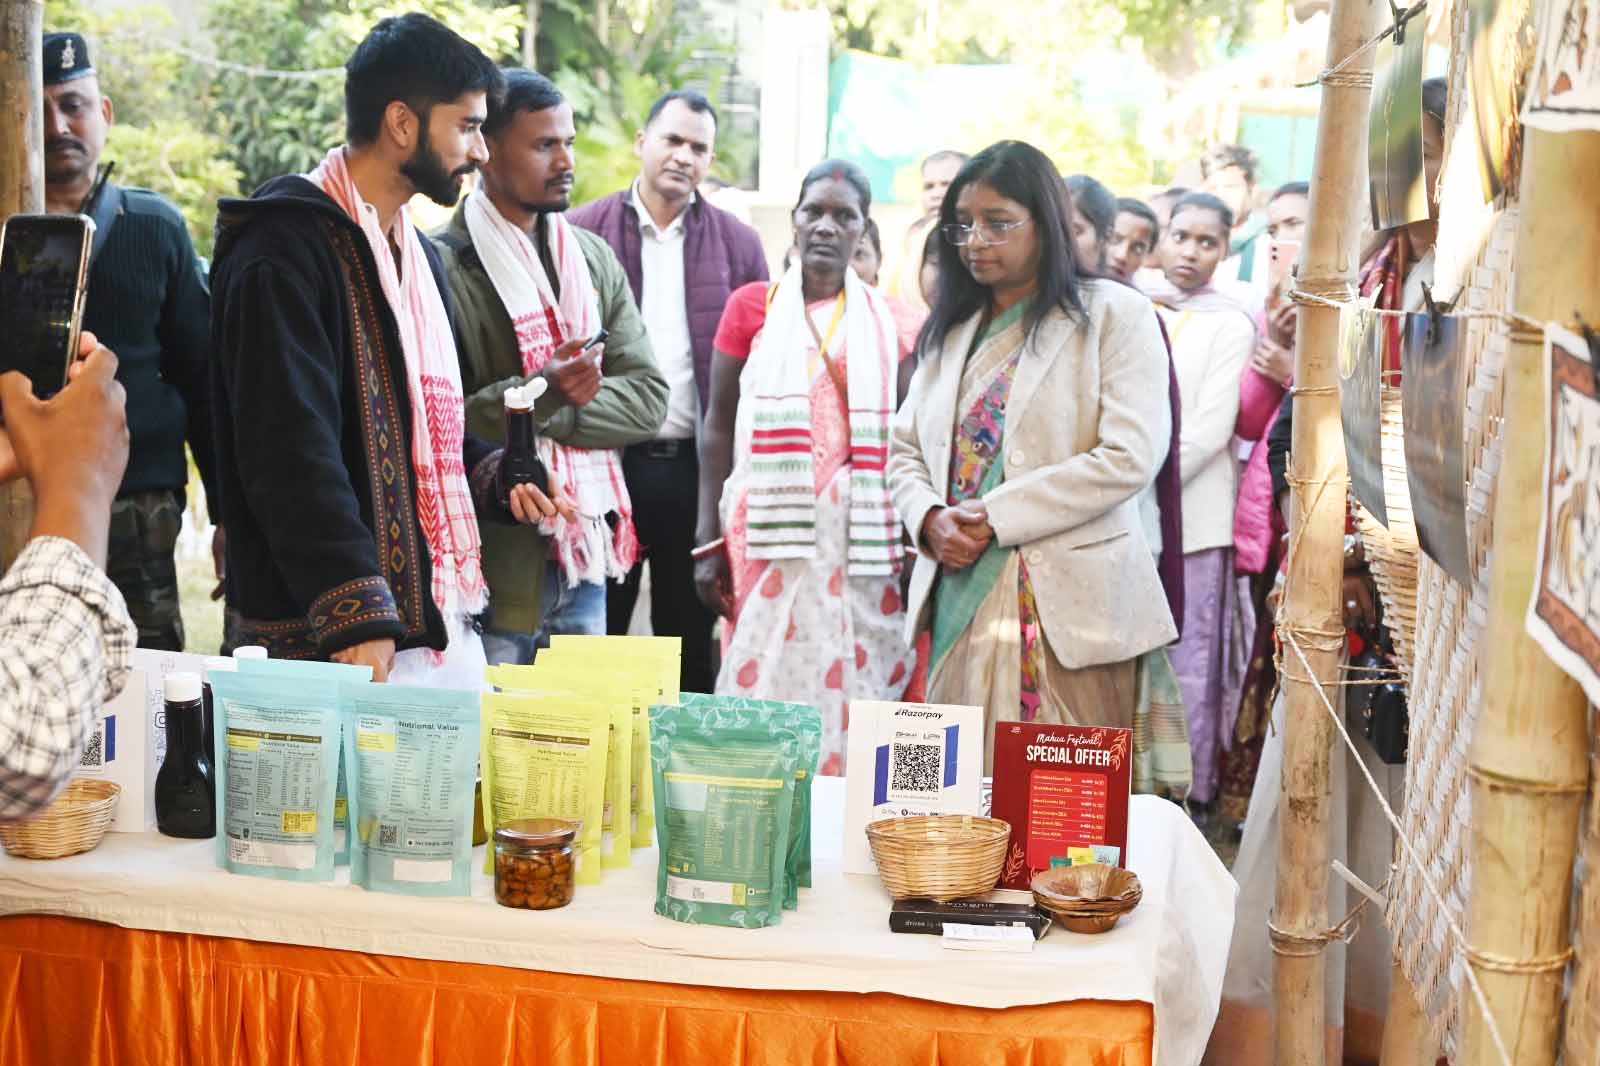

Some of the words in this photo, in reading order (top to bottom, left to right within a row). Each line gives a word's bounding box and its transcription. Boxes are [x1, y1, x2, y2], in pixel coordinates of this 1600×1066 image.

[901, 709, 943, 720] Razorpay
[1036, 731, 1066, 744] Mahua
[1066, 733, 1103, 747] Festival
[1026, 745, 1073, 764] SPECIAL
[1075, 748, 1110, 767] OFFER
